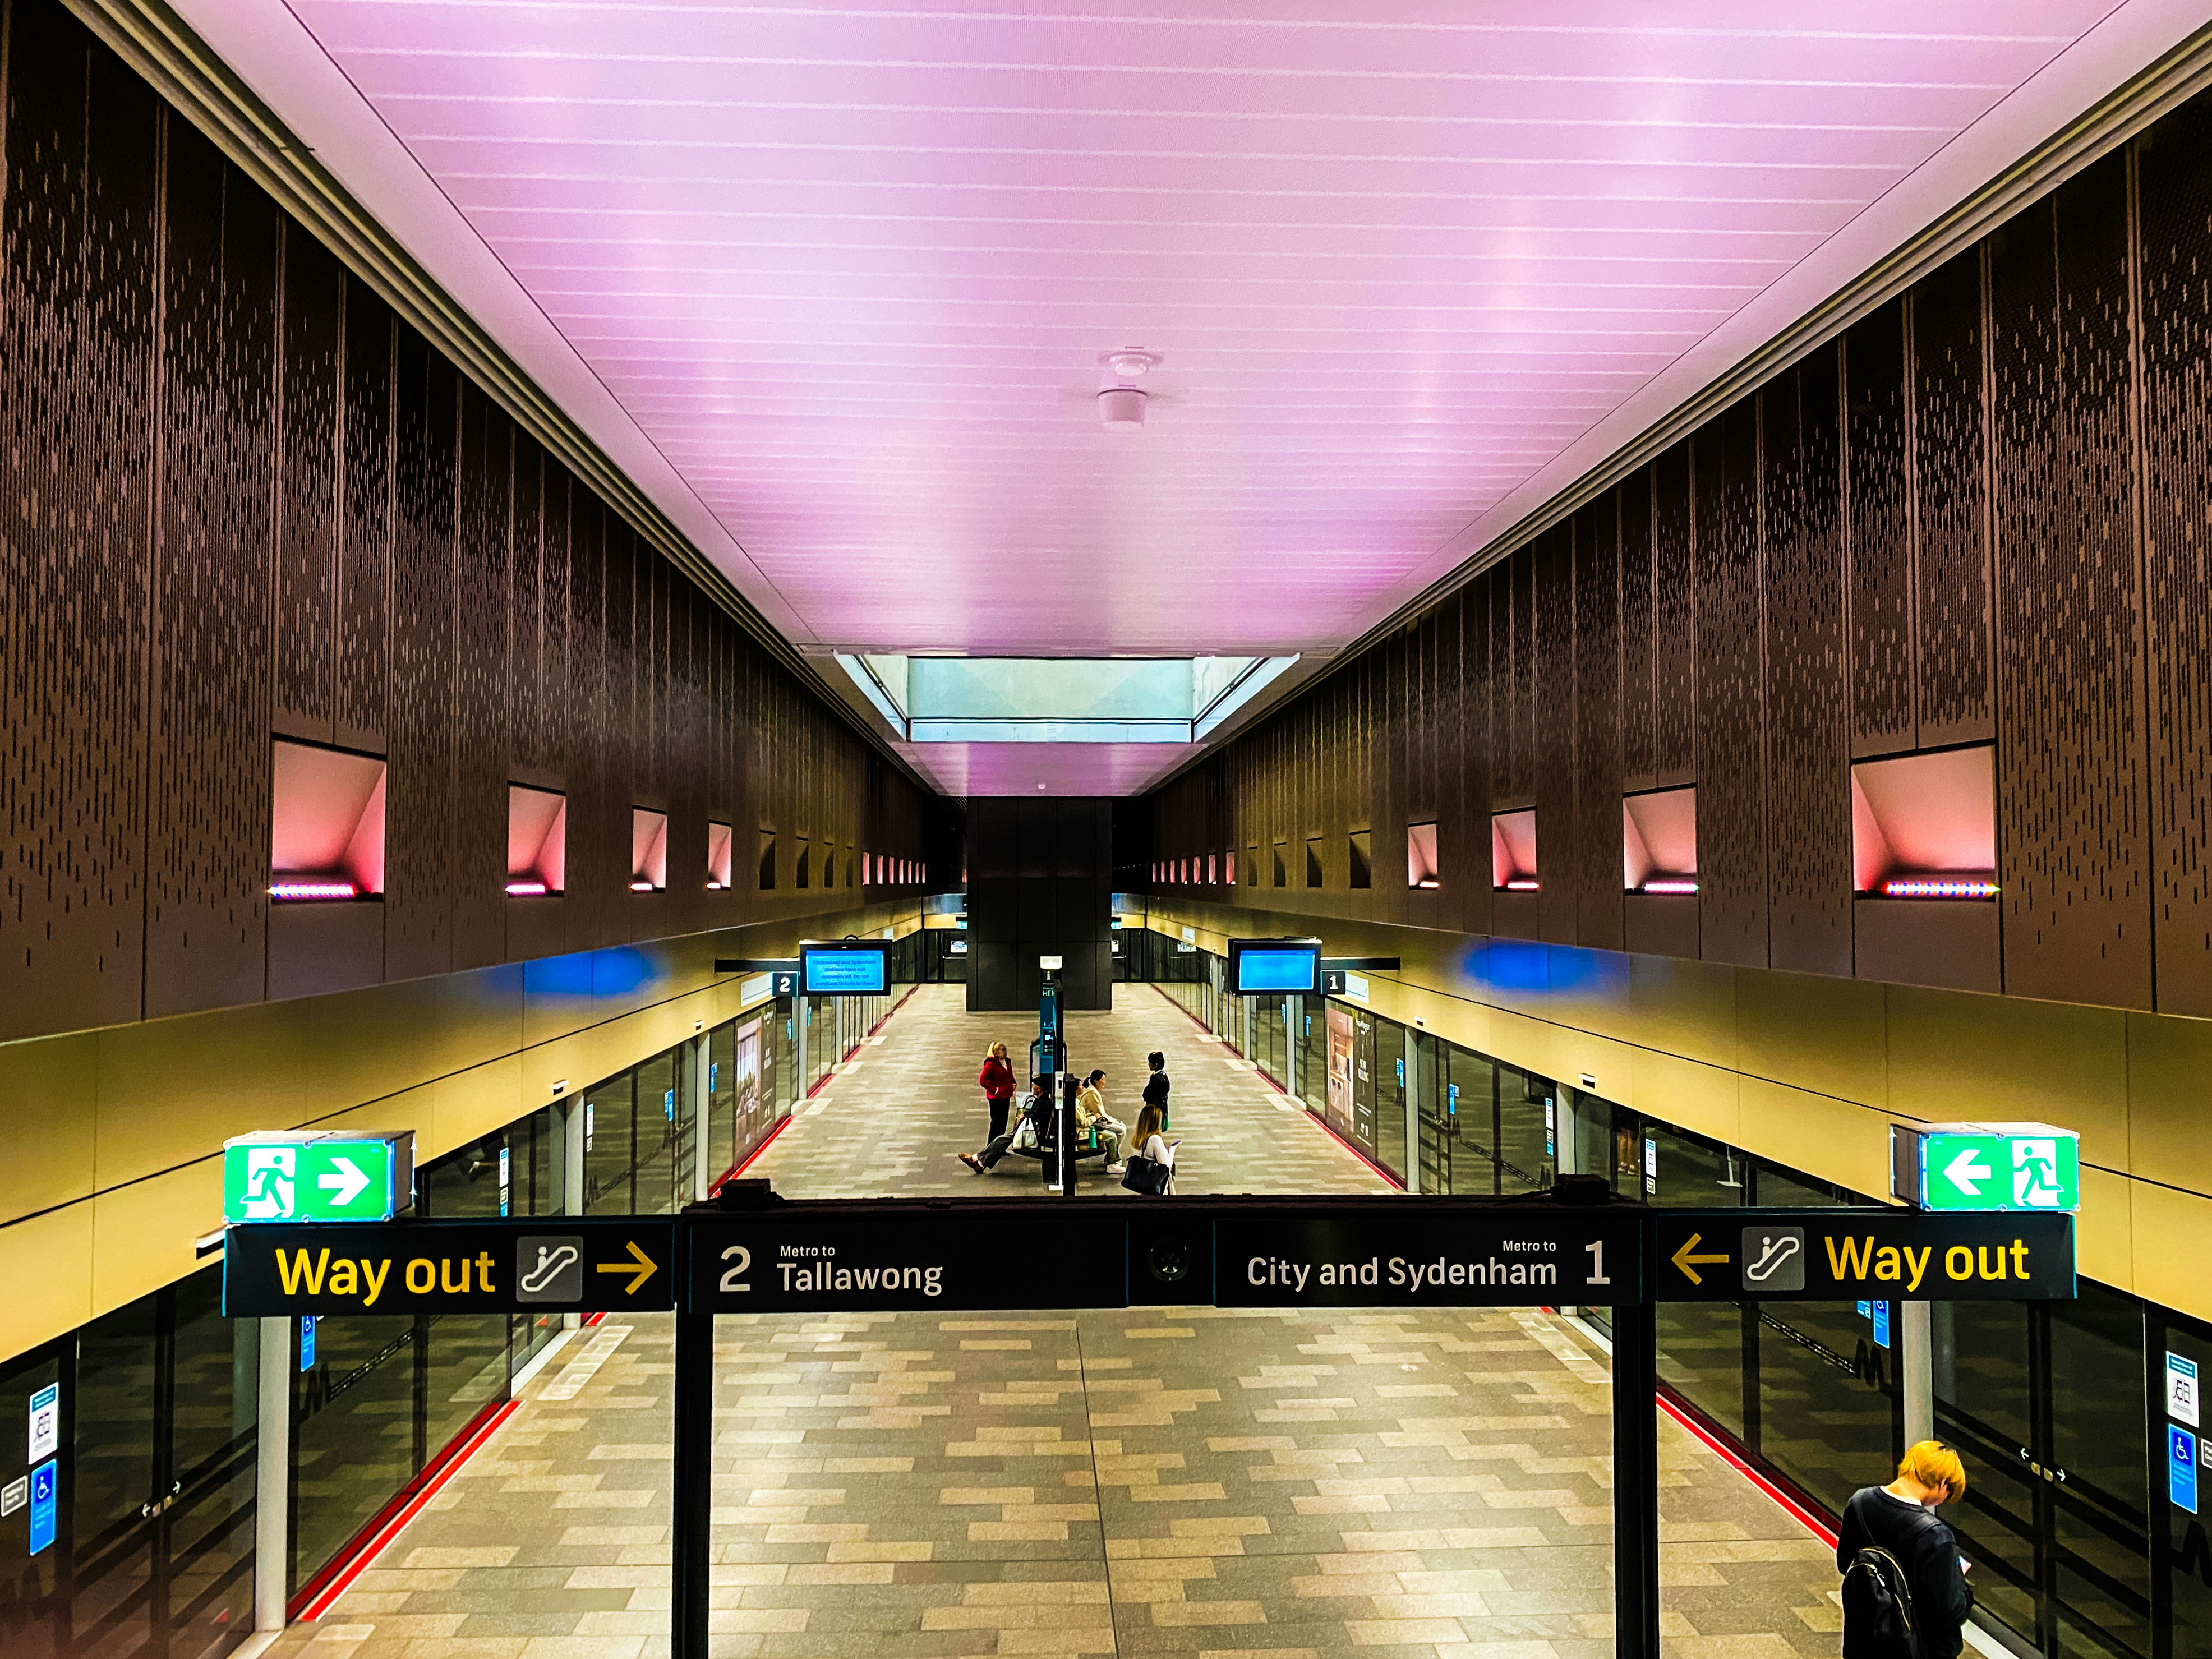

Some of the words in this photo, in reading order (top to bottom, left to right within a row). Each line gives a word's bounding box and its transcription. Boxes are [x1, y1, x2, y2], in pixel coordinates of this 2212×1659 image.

[780, 977, 790, 992] 2
[1329, 975, 1338, 990] 1
[781, 1246, 818, 1256] Metro
[822, 1246, 835, 1256] to
[1503, 1241, 1540, 1251] Metro
[1543, 1241, 1556, 1251] to
[1586, 1241, 1610, 1284] 1
[275, 1248, 391, 1306] Way
[406, 1252, 495, 1293] out
[720, 1246, 750, 1292] 2
[777, 1262, 943, 1296] Tallawong
[1248, 1257, 1310, 1292] City
[1320, 1257, 1377, 1285] and
[1389, 1257, 1556, 1292] Sydenham
[1824, 1236, 1932, 1292] Way
[1946, 1239, 2030, 1280] out
